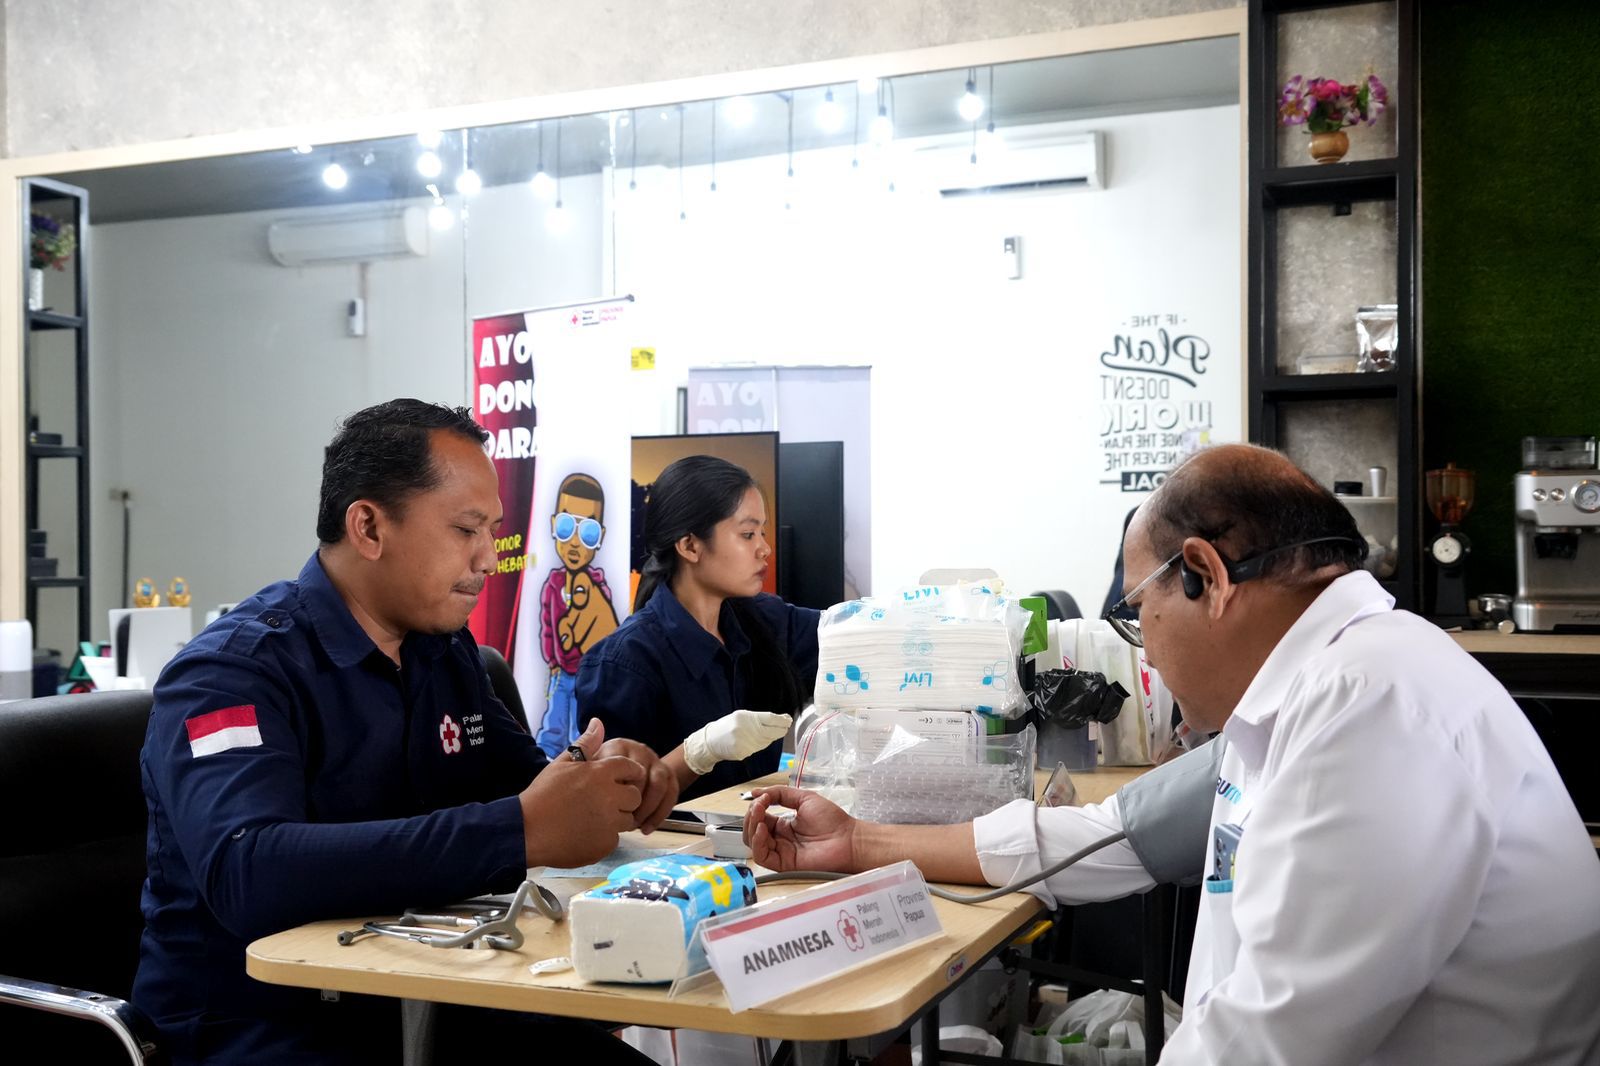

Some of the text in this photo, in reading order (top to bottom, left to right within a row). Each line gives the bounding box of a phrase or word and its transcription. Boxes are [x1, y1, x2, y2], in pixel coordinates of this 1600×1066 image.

[479, 331, 533, 368] AYO
[697, 382, 761, 406] AYO
[856, 901, 880, 915] Palang
[896, 891, 926, 908] Provinsi
[862, 917, 883, 930] Merah
[903, 909, 926, 923] Papua
[868, 928, 900, 945] Indonesia
[743, 929, 834, 975] ANAMNESA
